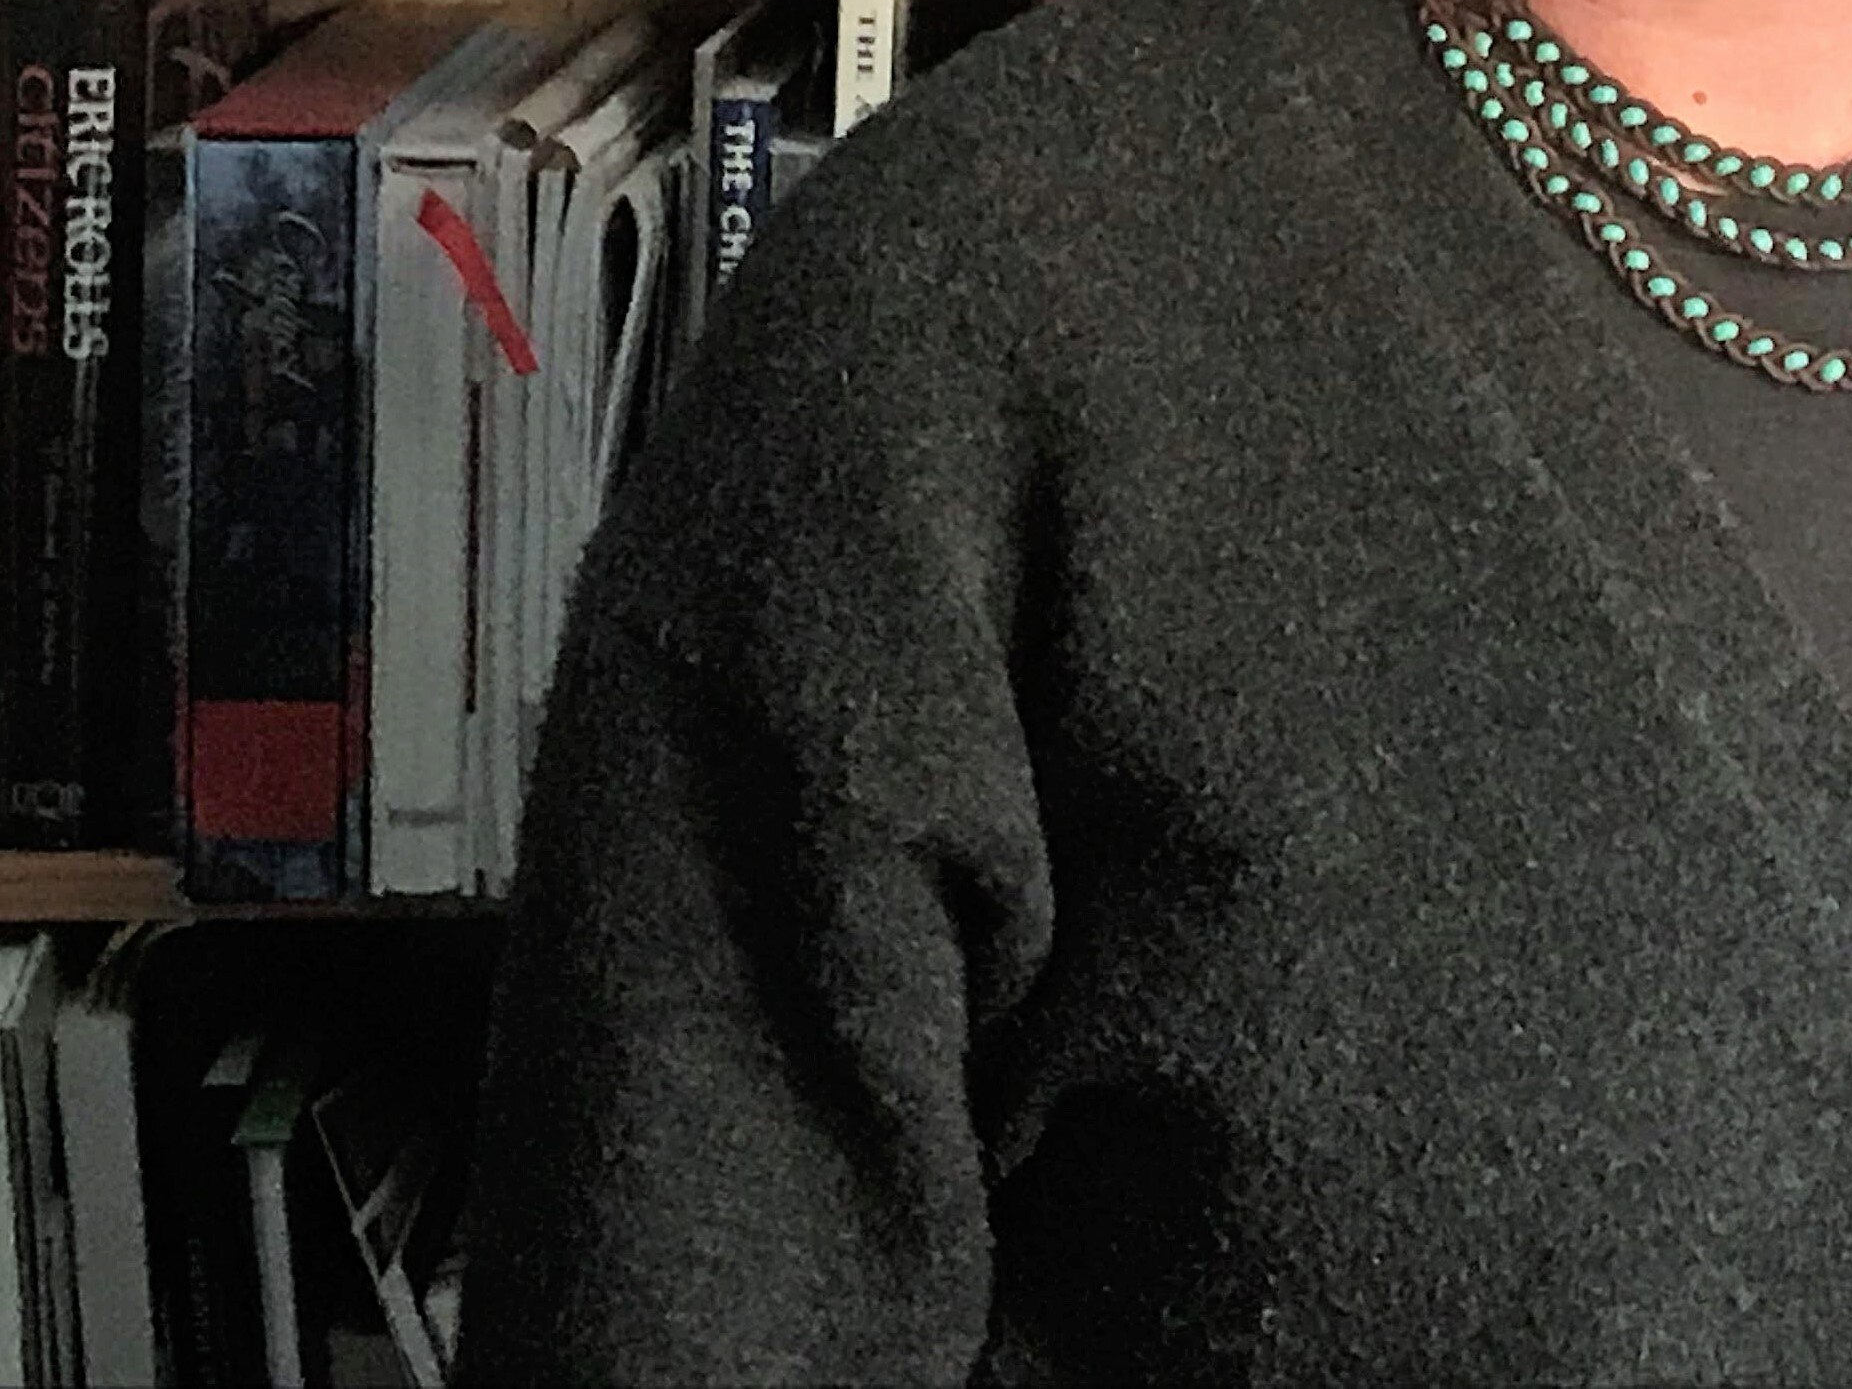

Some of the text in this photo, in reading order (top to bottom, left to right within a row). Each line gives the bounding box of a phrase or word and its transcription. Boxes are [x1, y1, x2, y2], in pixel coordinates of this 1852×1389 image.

[62, 67, 117, 360] ERIC ROLLS
[722, 118, 757, 192] THE
